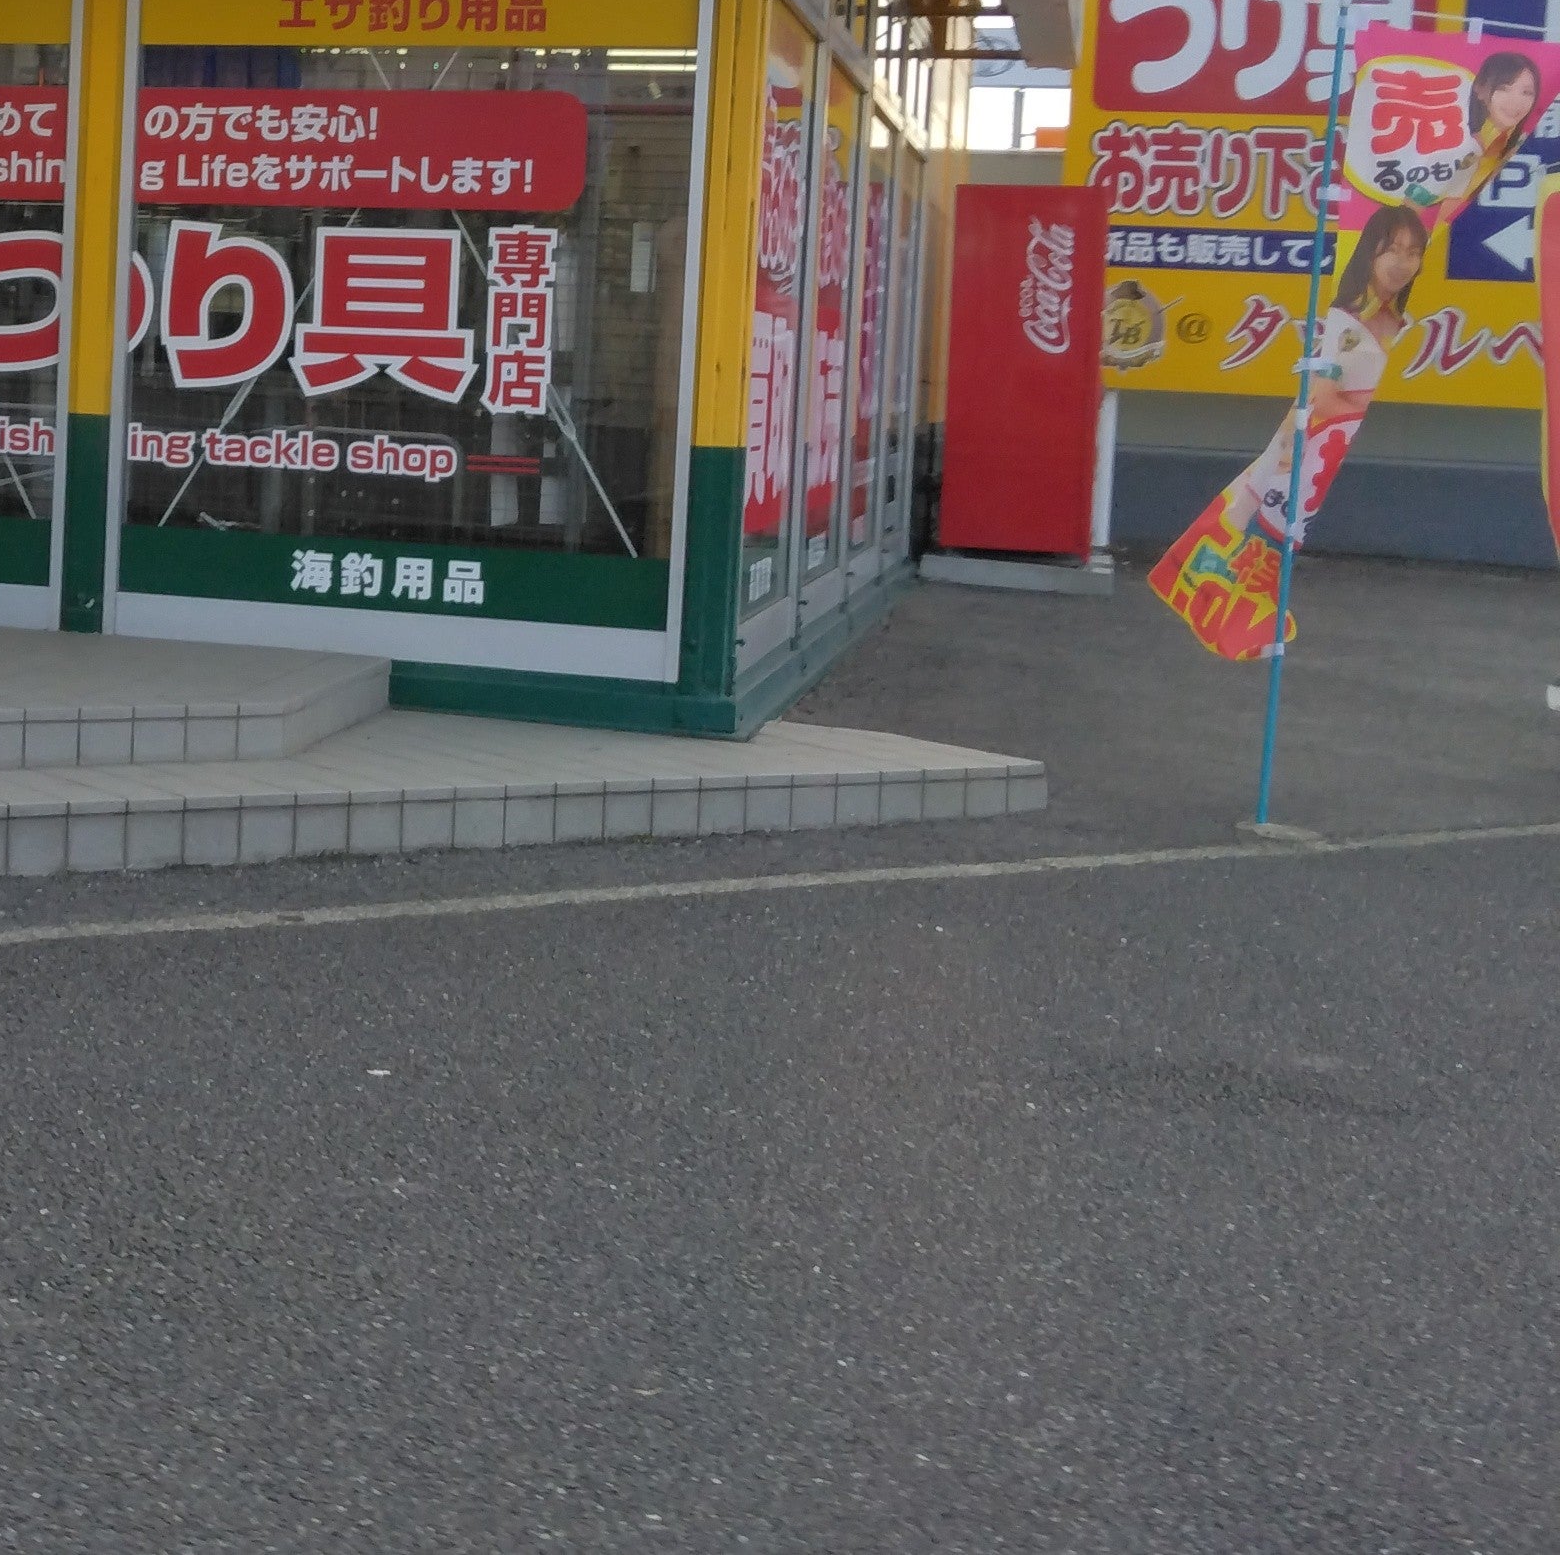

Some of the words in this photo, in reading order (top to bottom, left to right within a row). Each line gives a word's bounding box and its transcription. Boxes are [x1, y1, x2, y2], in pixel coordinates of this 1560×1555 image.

[1370, 68, 1465, 156] 売
[480, 224, 559, 417] 専門店
[202, 426, 342, 472] tackle
[346, 434, 458, 483] shop
[289, 548, 487, 606] 海釣用品
